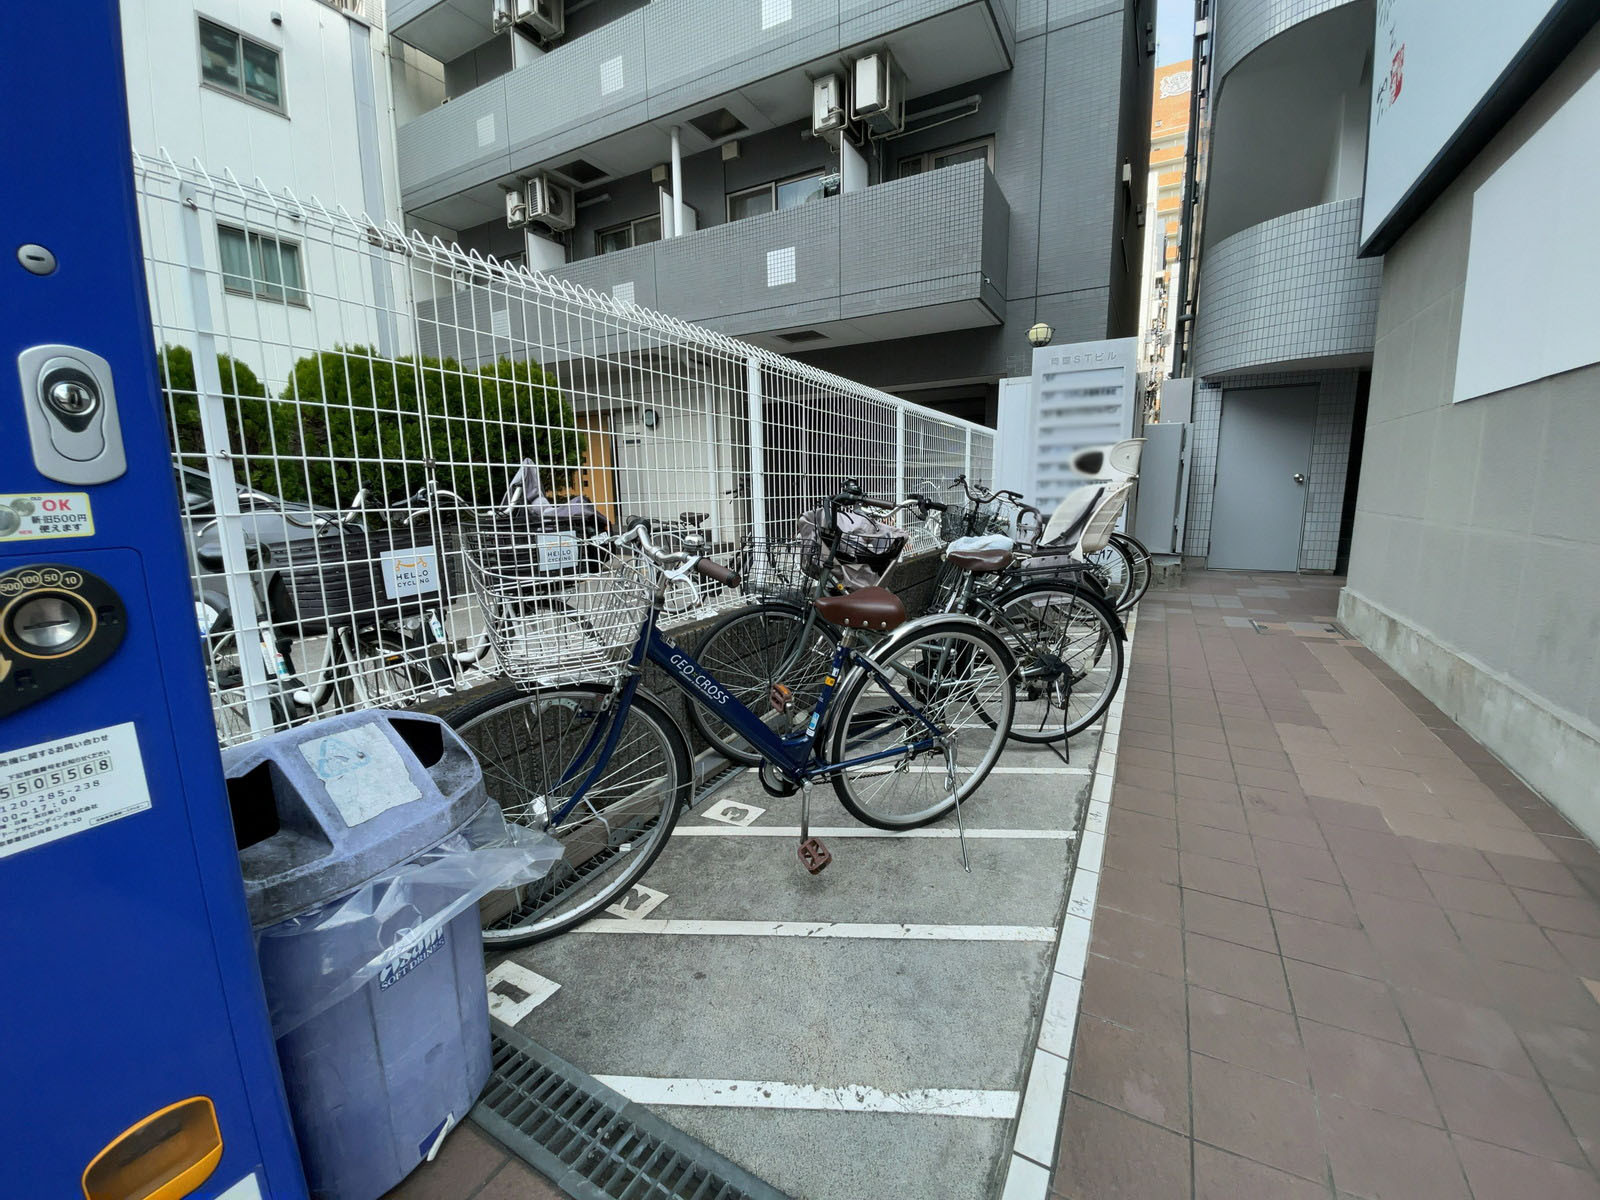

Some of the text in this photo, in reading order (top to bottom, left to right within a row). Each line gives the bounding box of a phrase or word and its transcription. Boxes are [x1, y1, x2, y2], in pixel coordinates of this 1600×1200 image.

[42, 499, 72, 511] OK
[31, 513, 87, 524] 新旧500円
[39, 523, 82, 533] 使えます
[0, 573, 77, 592] 500 100 50 10
[397, 577, 430, 588] CYCLNG
[670, 654, 694, 675] GEO
[695, 675, 730, 705] CROSS
[720, 806, 750, 822] 3
[381, 966, 408, 991] SOFT
